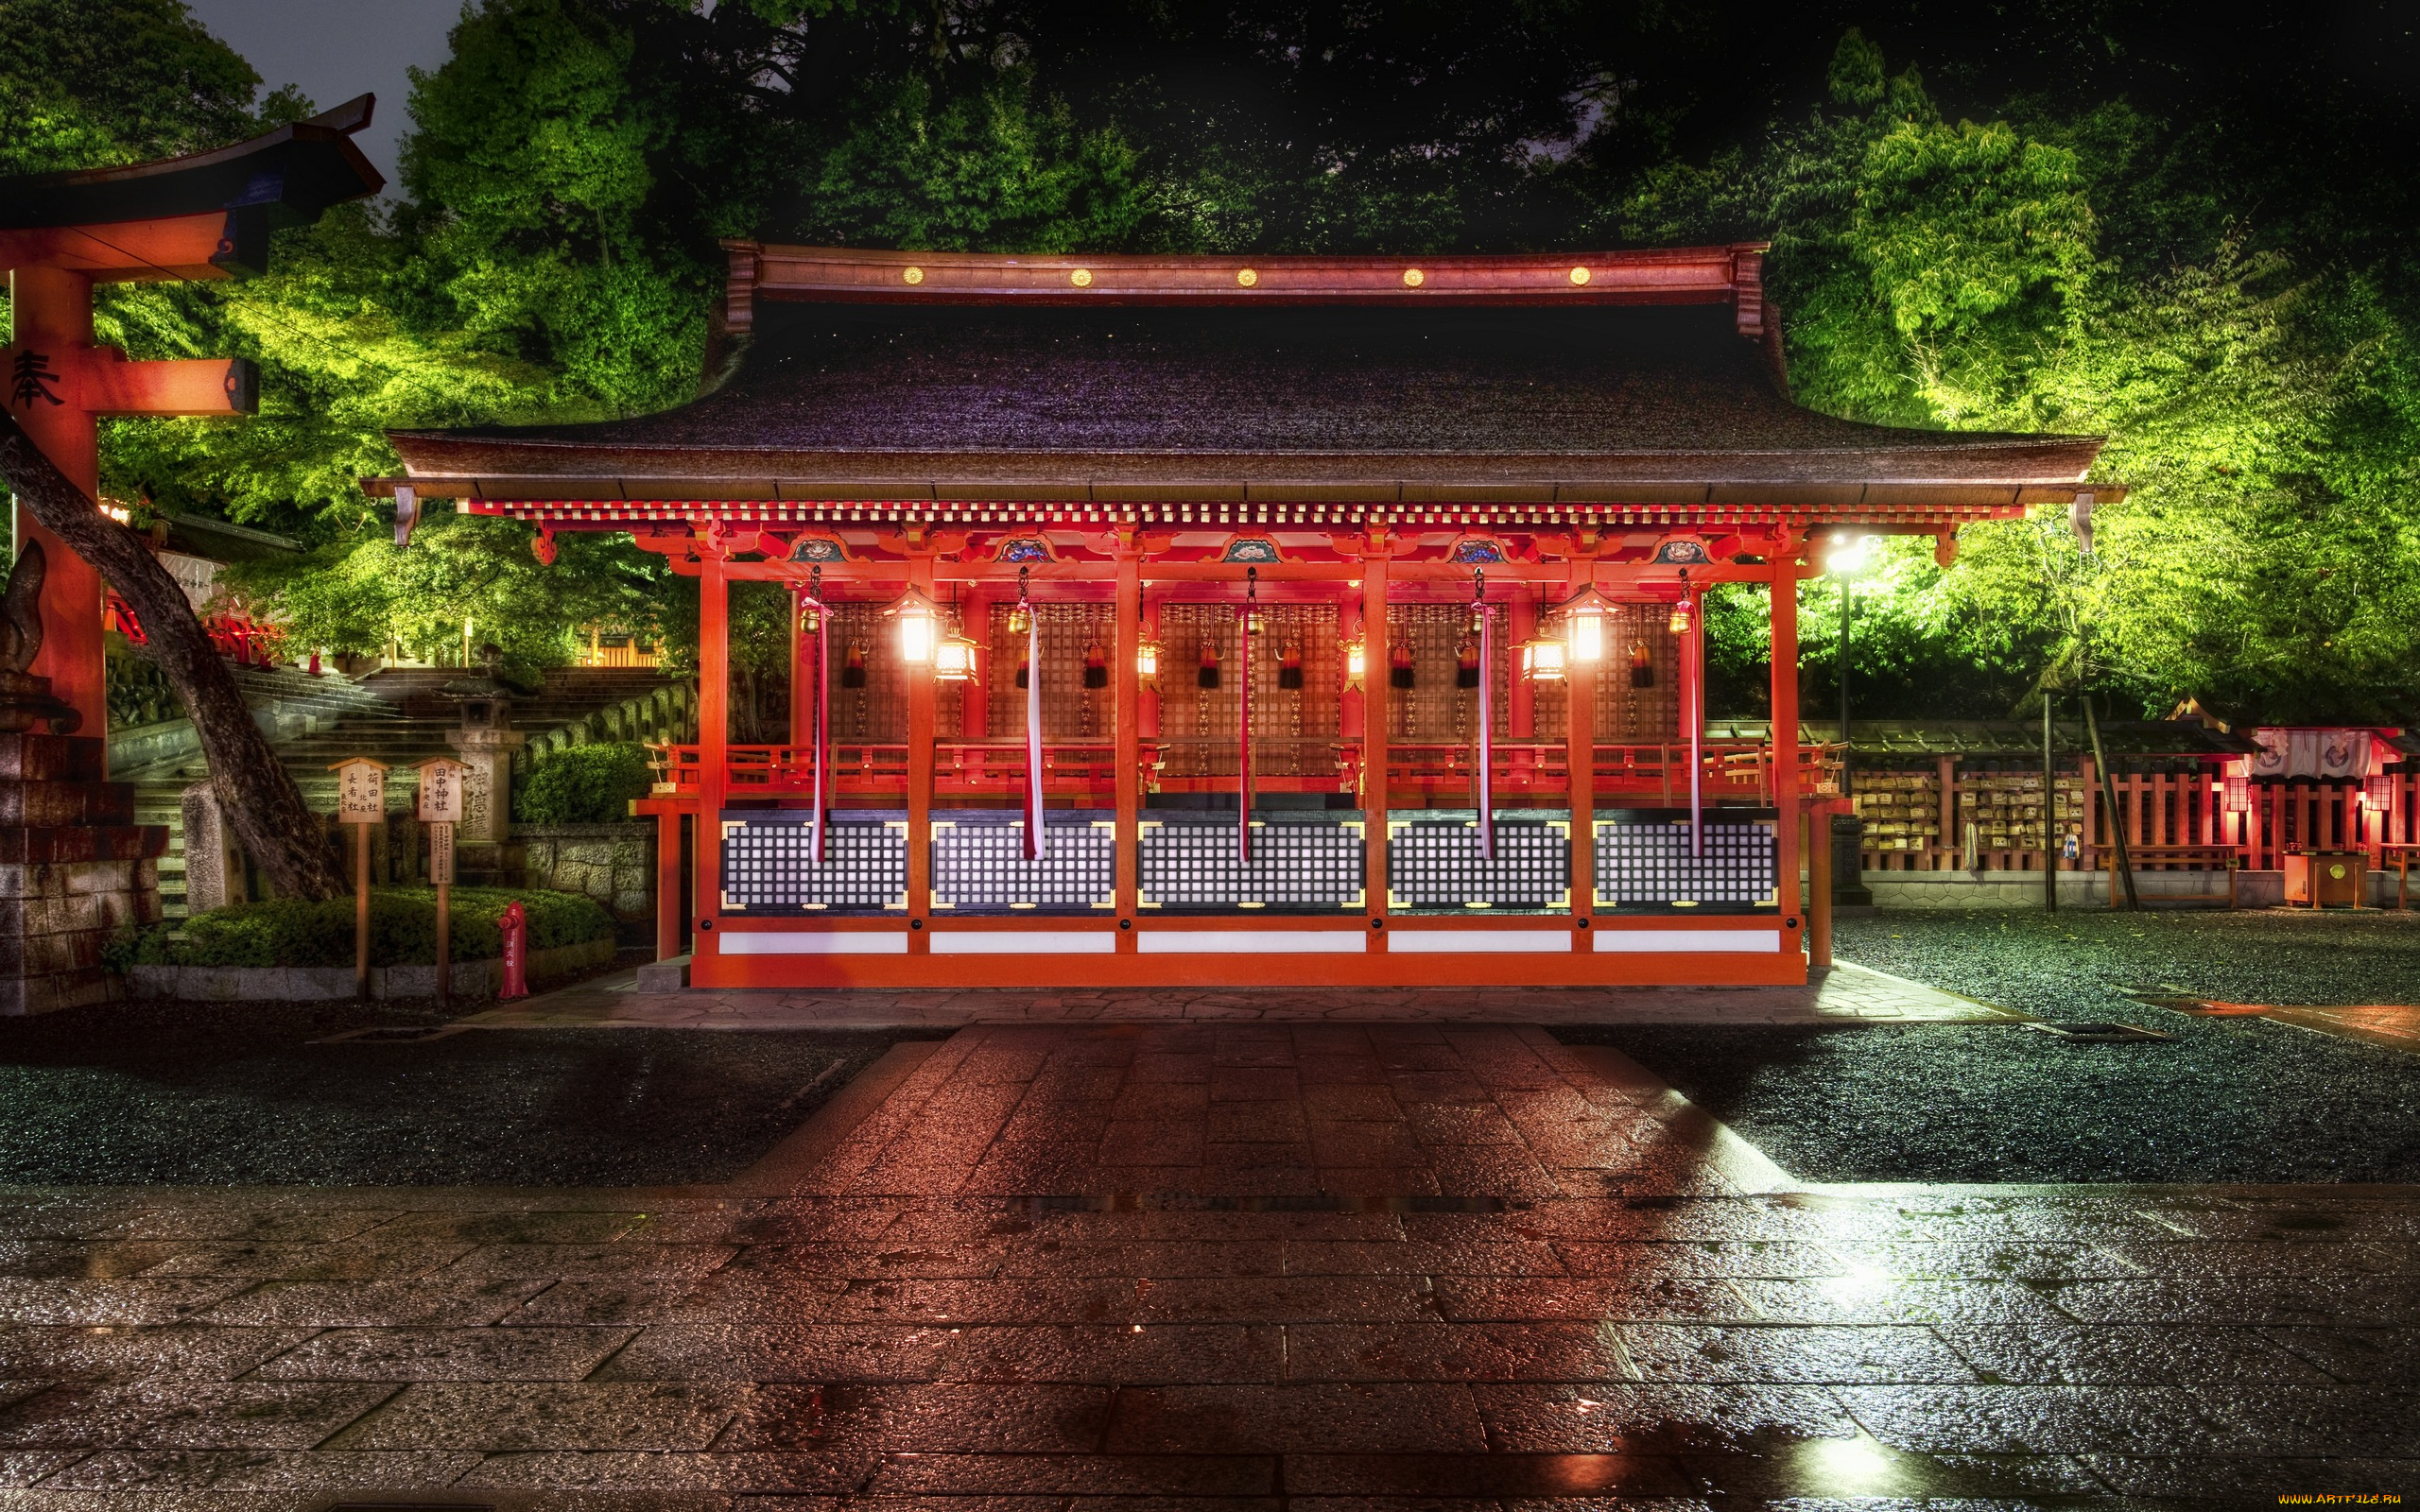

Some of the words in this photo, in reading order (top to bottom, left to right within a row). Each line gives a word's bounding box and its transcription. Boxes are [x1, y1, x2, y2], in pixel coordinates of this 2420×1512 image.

[11, 349, 66, 409] 奉
[347, 772, 359, 812] 長者社
[359, 794, 367, 813] 北座
[367, 772, 379, 813] 荷田社
[434, 767, 449, 812] 田中神社
[506, 940, 515, 967] 消火栓
